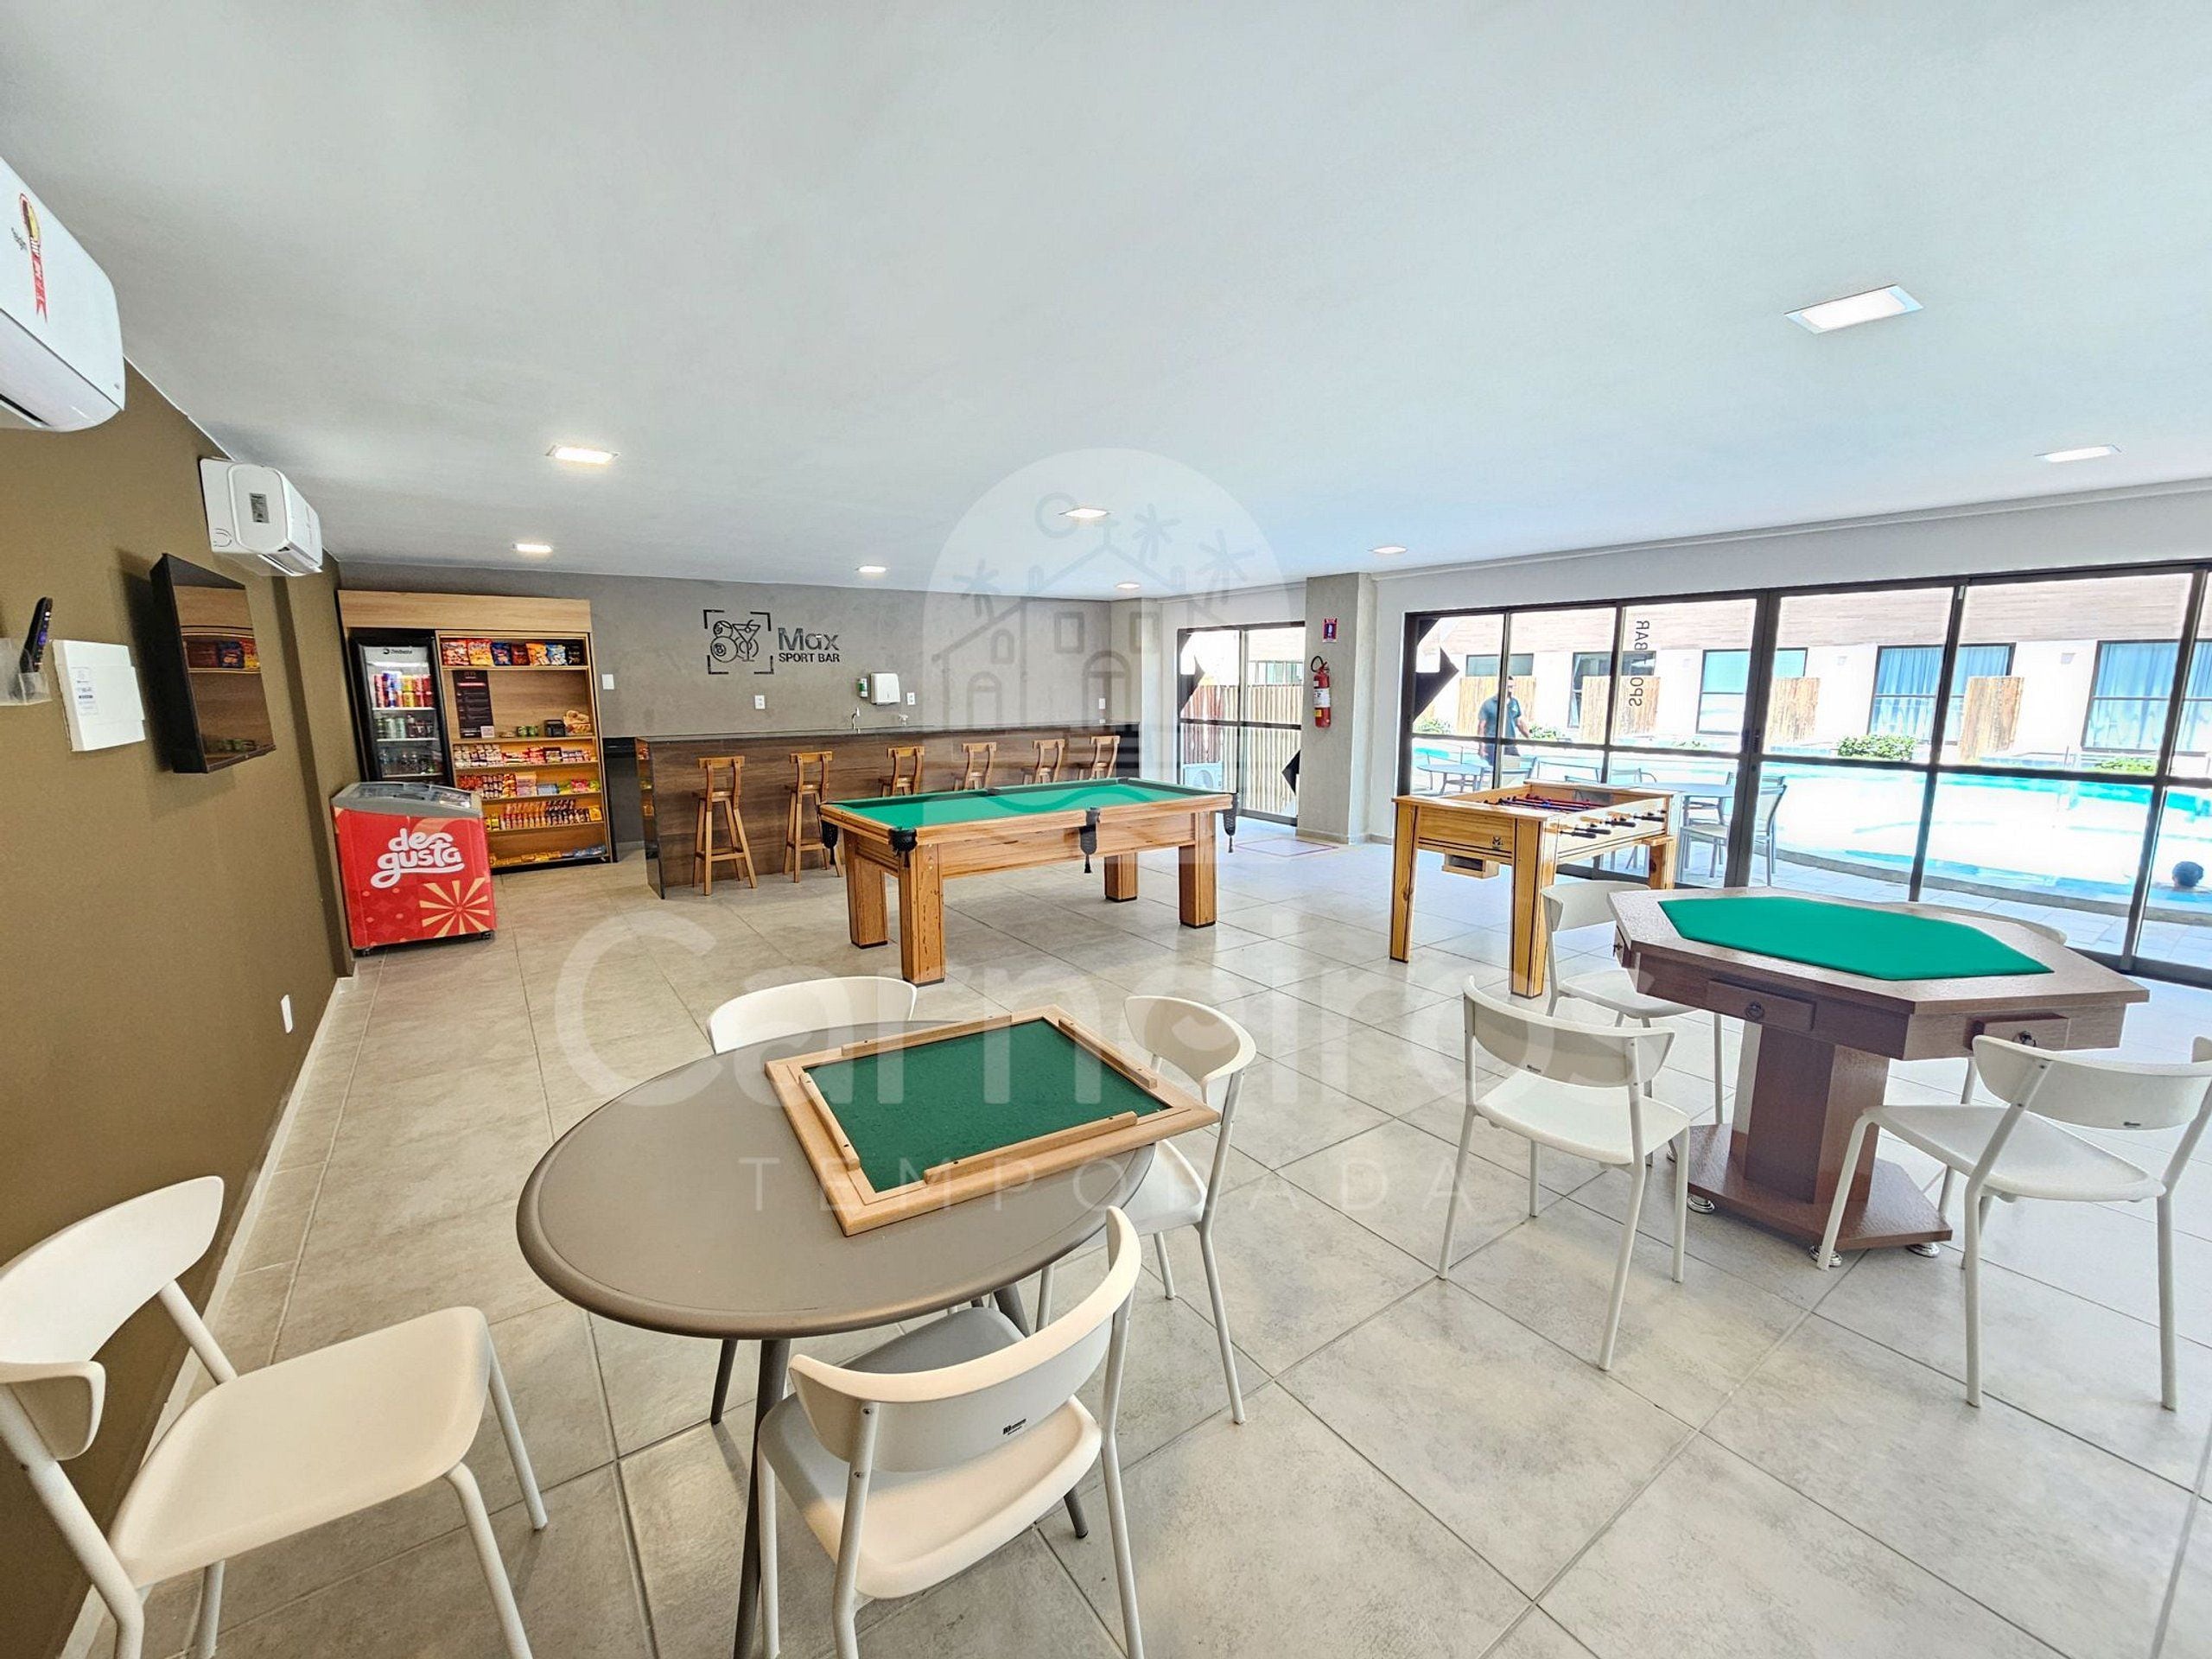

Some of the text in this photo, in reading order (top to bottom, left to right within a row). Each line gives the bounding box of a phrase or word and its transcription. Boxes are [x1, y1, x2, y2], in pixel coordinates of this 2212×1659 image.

[778, 627, 839, 651] Max
[779, 652, 840, 663] SPORT BAR
[370, 839, 465, 888] gusta
